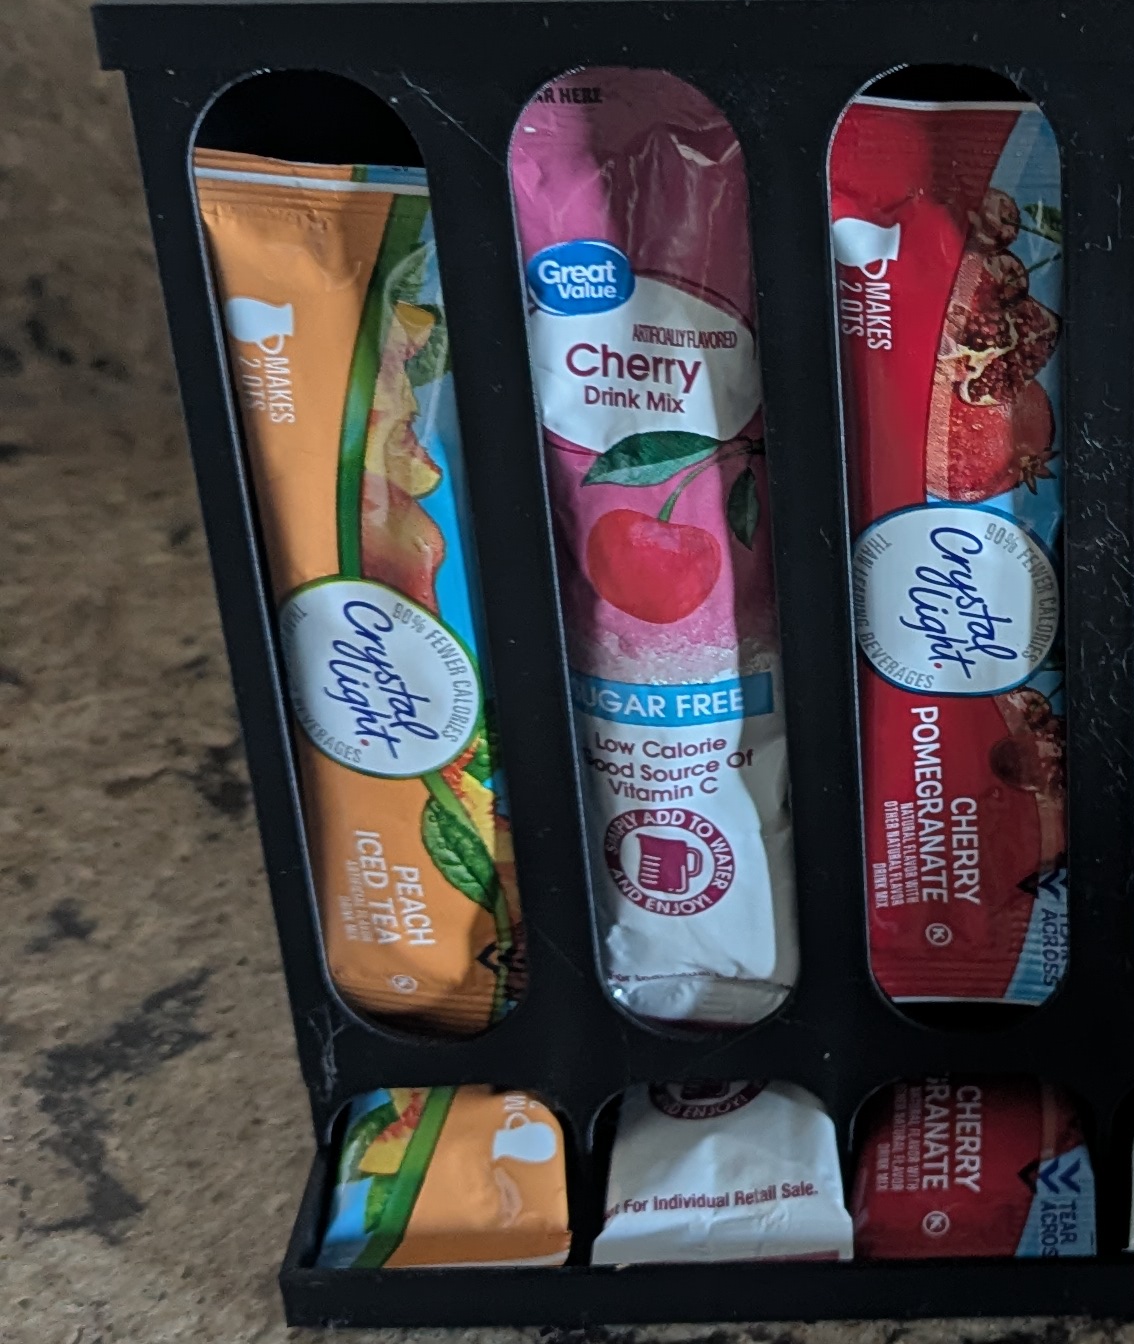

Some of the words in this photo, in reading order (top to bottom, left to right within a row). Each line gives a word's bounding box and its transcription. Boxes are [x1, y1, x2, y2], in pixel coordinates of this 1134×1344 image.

[537, 260, 617, 285] Great
[557, 281, 617, 300] Value
[838, 282, 854, 293] 2
[688, 329, 738, 350] FLAVORED
[864, 281, 893, 352] MAKES
[263, 356, 296, 424] MAKES
[565, 342, 702, 394] Cherry
[583, 384, 640, 410] Drink
[645, 389, 686, 414] Mix
[856, 532, 893, 570] THAN
[984, 523, 1020, 554] 90%
[915, 526, 1018, 660] Crystal
[1017, 547, 1055, 594] FEWER
[424, 628, 469, 677] FEWER
[1020, 596, 1058, 663] CALORIES
[332, 600, 440, 740] Crystal
[860, 631, 935, 689] BEVERAGES
[440, 679, 474, 743] CALORIES
[579, 684, 667, 718] UGAR
[676, 686, 745, 719] FREE
[595, 731, 635, 756] Low
[642, 736, 728, 760] Calorie
[641, 755, 720, 783] Source
[726, 749, 755, 769] Of
[608, 777, 694, 804] Vitamin
[699, 777, 719, 795] C
[911, 705, 949, 904] POMEGRANATE
[354, 829, 389, 890] ICED
[643, 810, 686, 826] ADD
[688, 816, 715, 839] TO
[709, 836, 734, 891] WATER
[949, 796, 982, 906] CHERRY
[392, 865, 436, 946] PEACH
[609, 867, 643, 902] AND
[644, 893, 713, 915] ENJOY!
[368, 897, 401, 945] TEA
[1040, 907, 1059, 987] ACROSS
[954, 1085, 982, 1193] CHERRY
[623, 1198, 649, 1214] For
[653, 1191, 730, 1211] Individual
[734, 1184, 777, 1207] Retail
[780, 1180, 819, 1200] Sale.
[1059, 1199, 1078, 1246] TEAR
